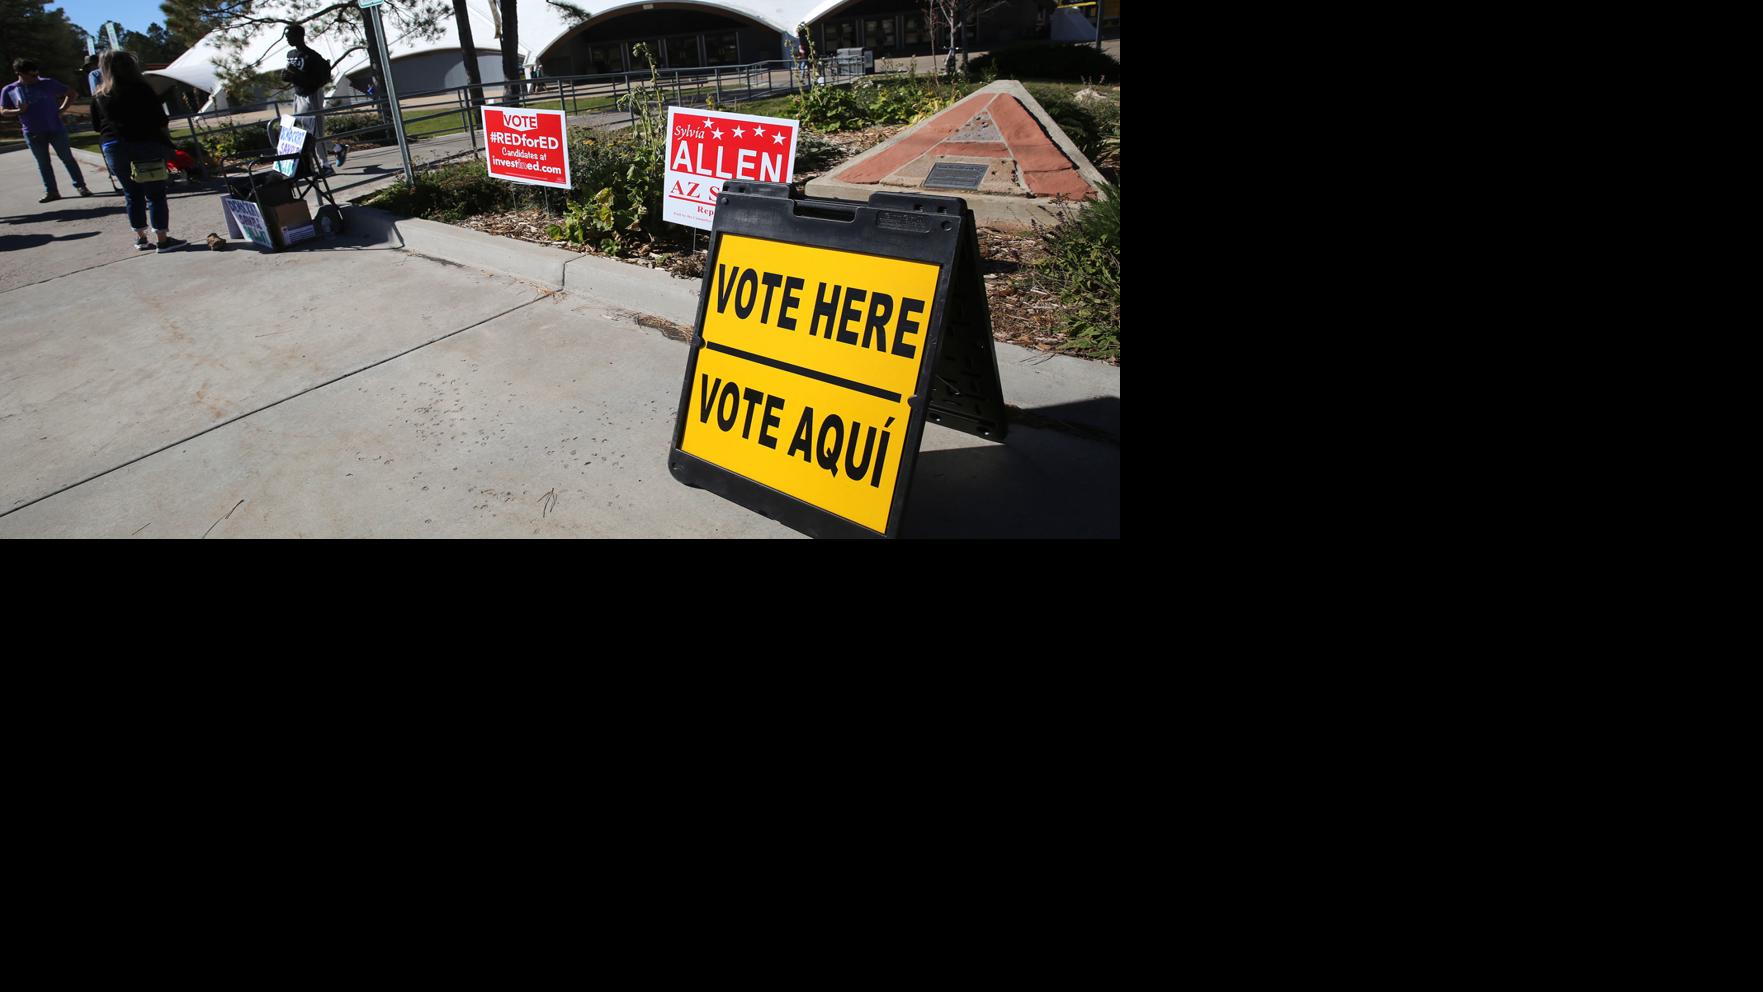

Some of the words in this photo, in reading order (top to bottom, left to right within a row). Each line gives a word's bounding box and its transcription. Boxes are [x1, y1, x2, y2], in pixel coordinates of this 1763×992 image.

[503, 114, 537, 128] VOTE
[490, 132, 559, 150] #REDforED
[674, 124, 705, 140] Sylvia
[501, 146, 538, 160] Candidates
[540, 153, 547, 161] at
[672, 140, 783, 182] ALLEN
[670, 179, 700, 199] AZ
[697, 205, 714, 217] Rep
[716, 263, 805, 331] VOTE
[809, 281, 925, 359] HERE
[699, 373, 785, 450] VOTE
[787, 405, 895, 488] AQUÍ
